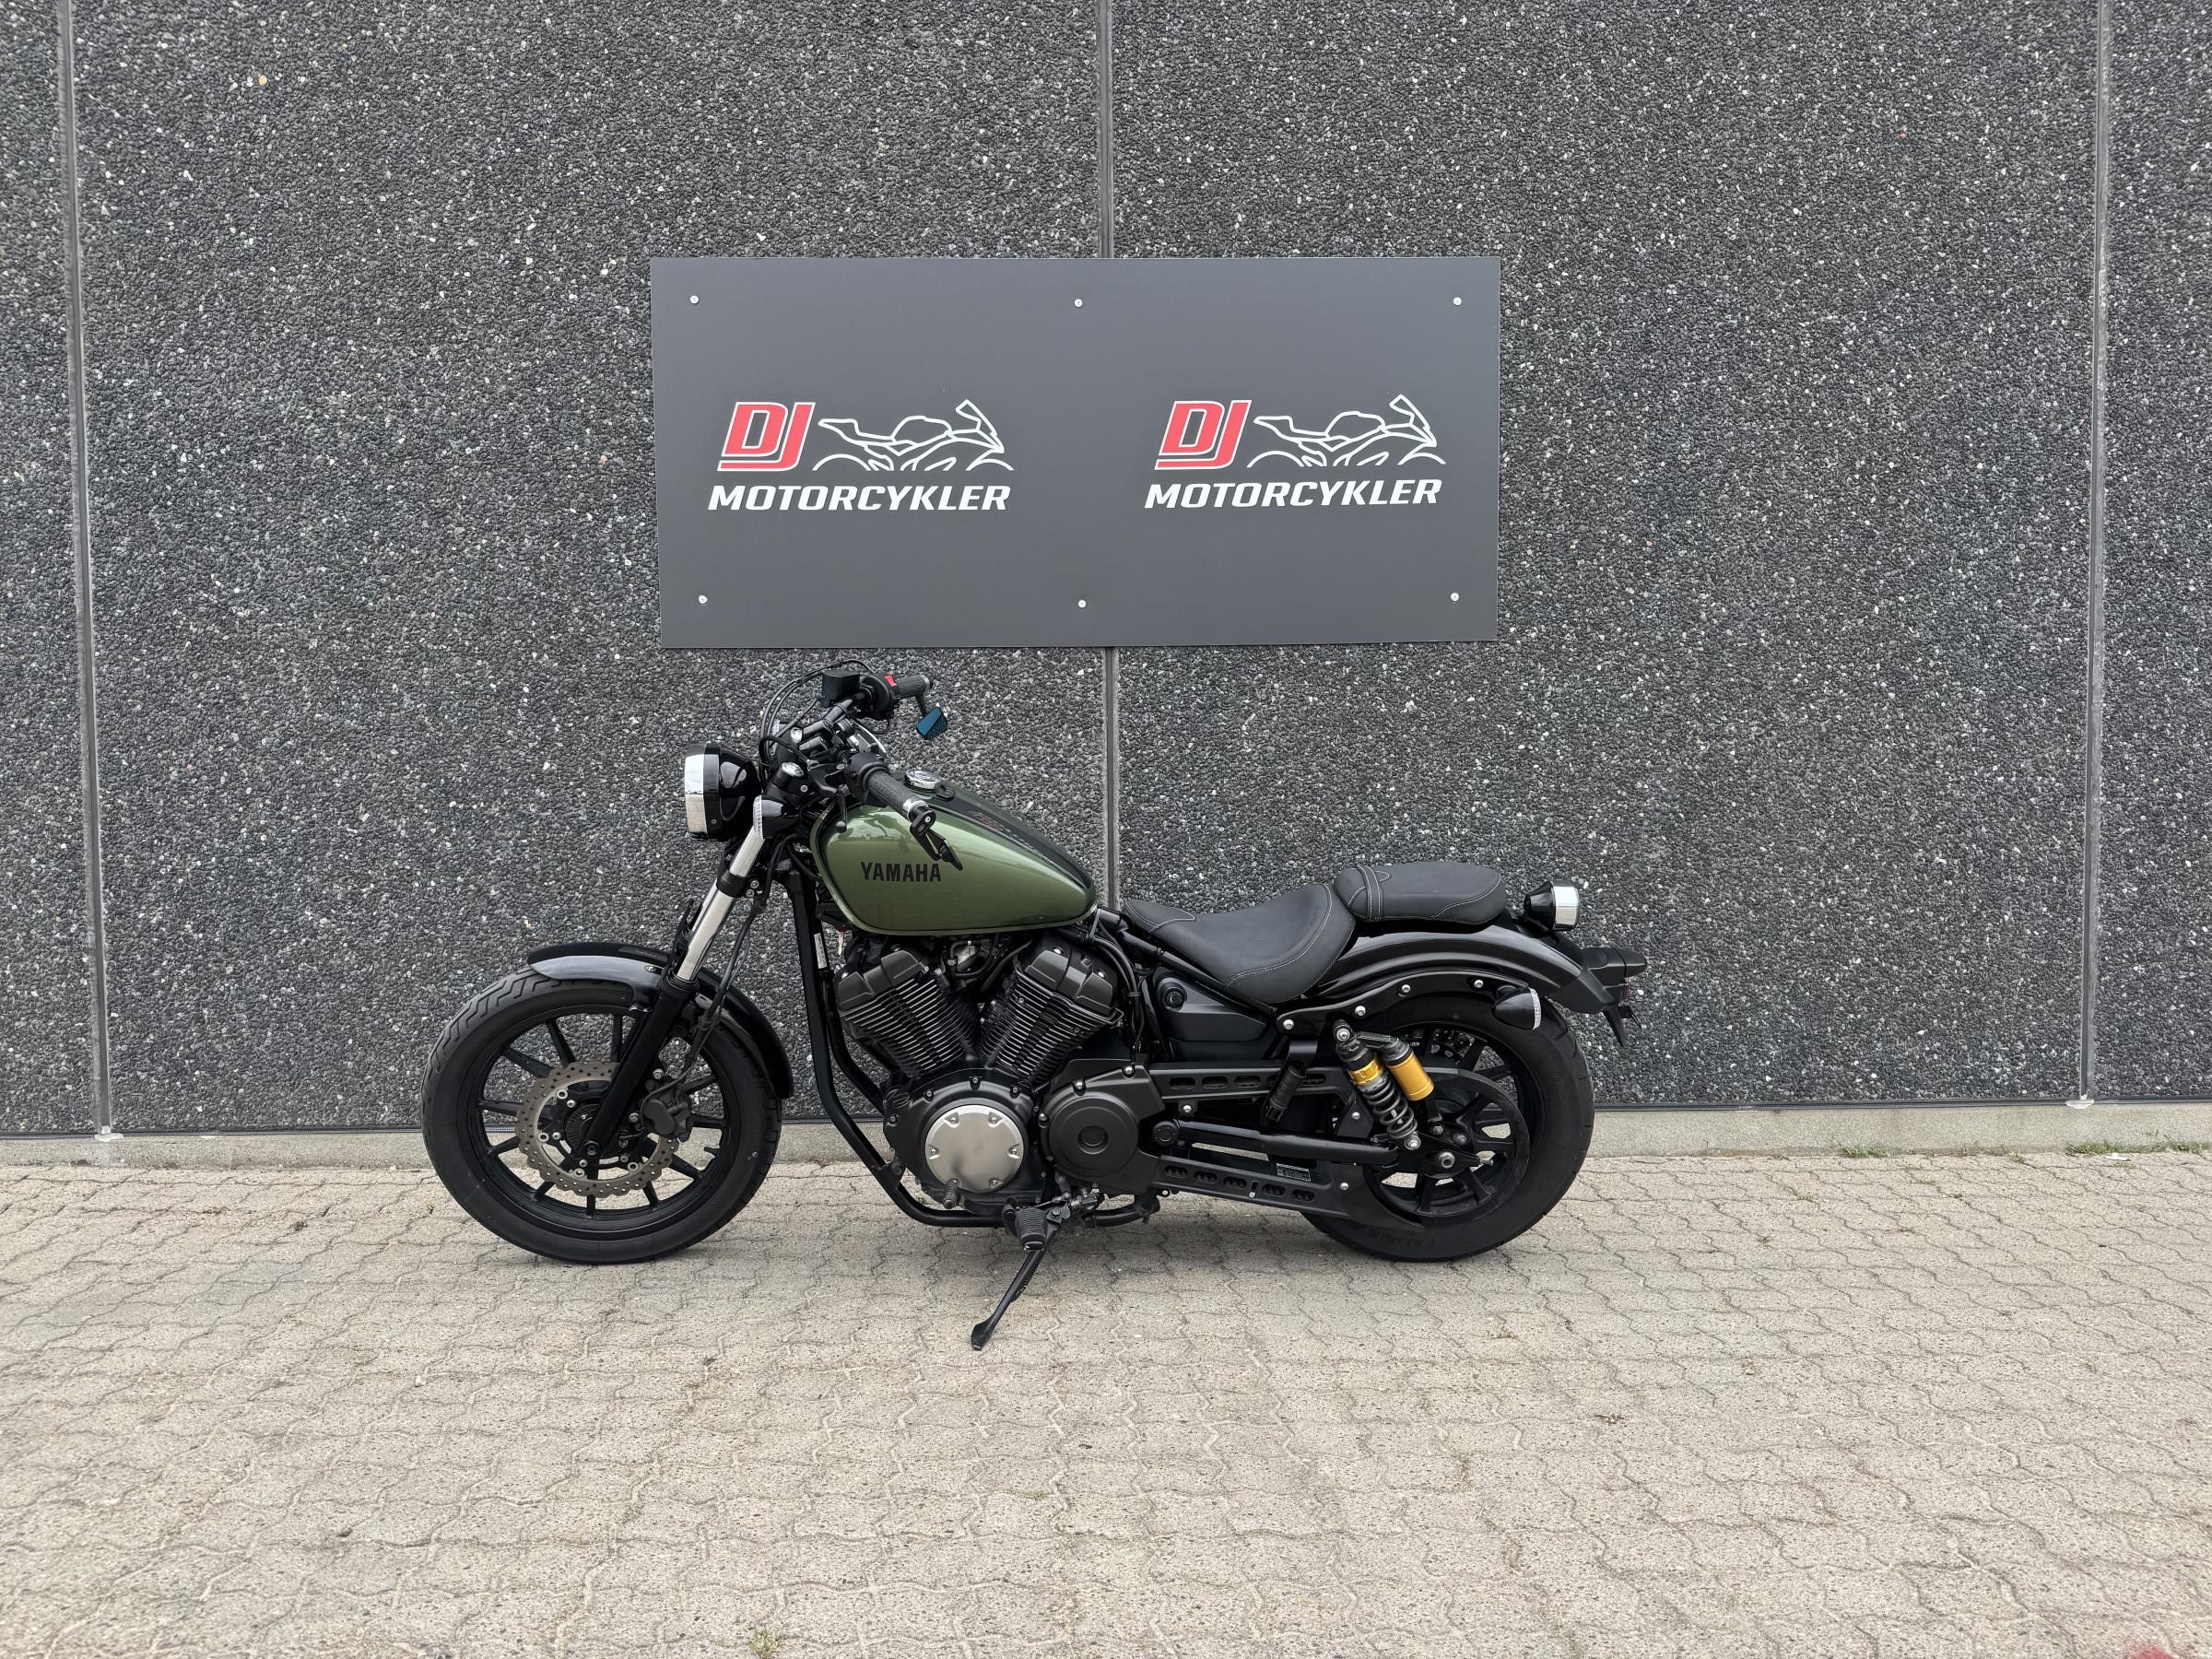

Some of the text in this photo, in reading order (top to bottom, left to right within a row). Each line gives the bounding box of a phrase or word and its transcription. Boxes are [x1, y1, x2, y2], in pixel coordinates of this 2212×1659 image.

[717, 401, 816, 472] DJ
[1154, 400, 1252, 471] DJ
[708, 486, 1011, 511] MOTORCYKLER
[1145, 479, 1442, 509] MOTORCYKLER
[860, 862, 941, 882] YAMAHA
